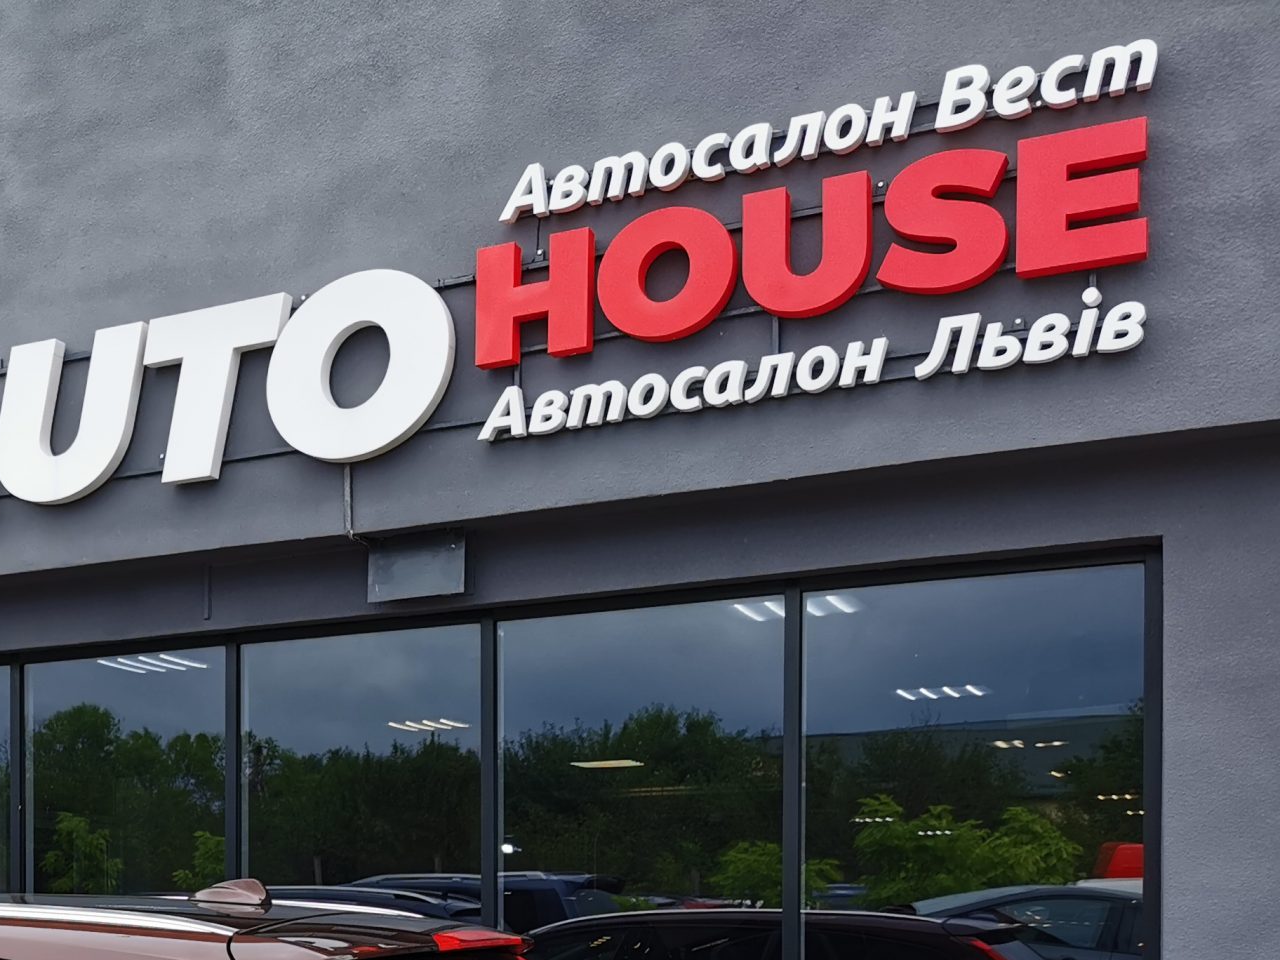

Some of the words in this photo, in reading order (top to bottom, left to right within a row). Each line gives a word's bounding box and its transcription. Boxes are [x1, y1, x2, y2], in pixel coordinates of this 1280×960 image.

[498, 91, 917, 225] Автосалон
[934, 38, 1159, 132] Вест
[475, 117, 1150, 370] HOUSE
[477, 336, 889, 443] Автосалон
[914, 287, 1148, 380] Львів
